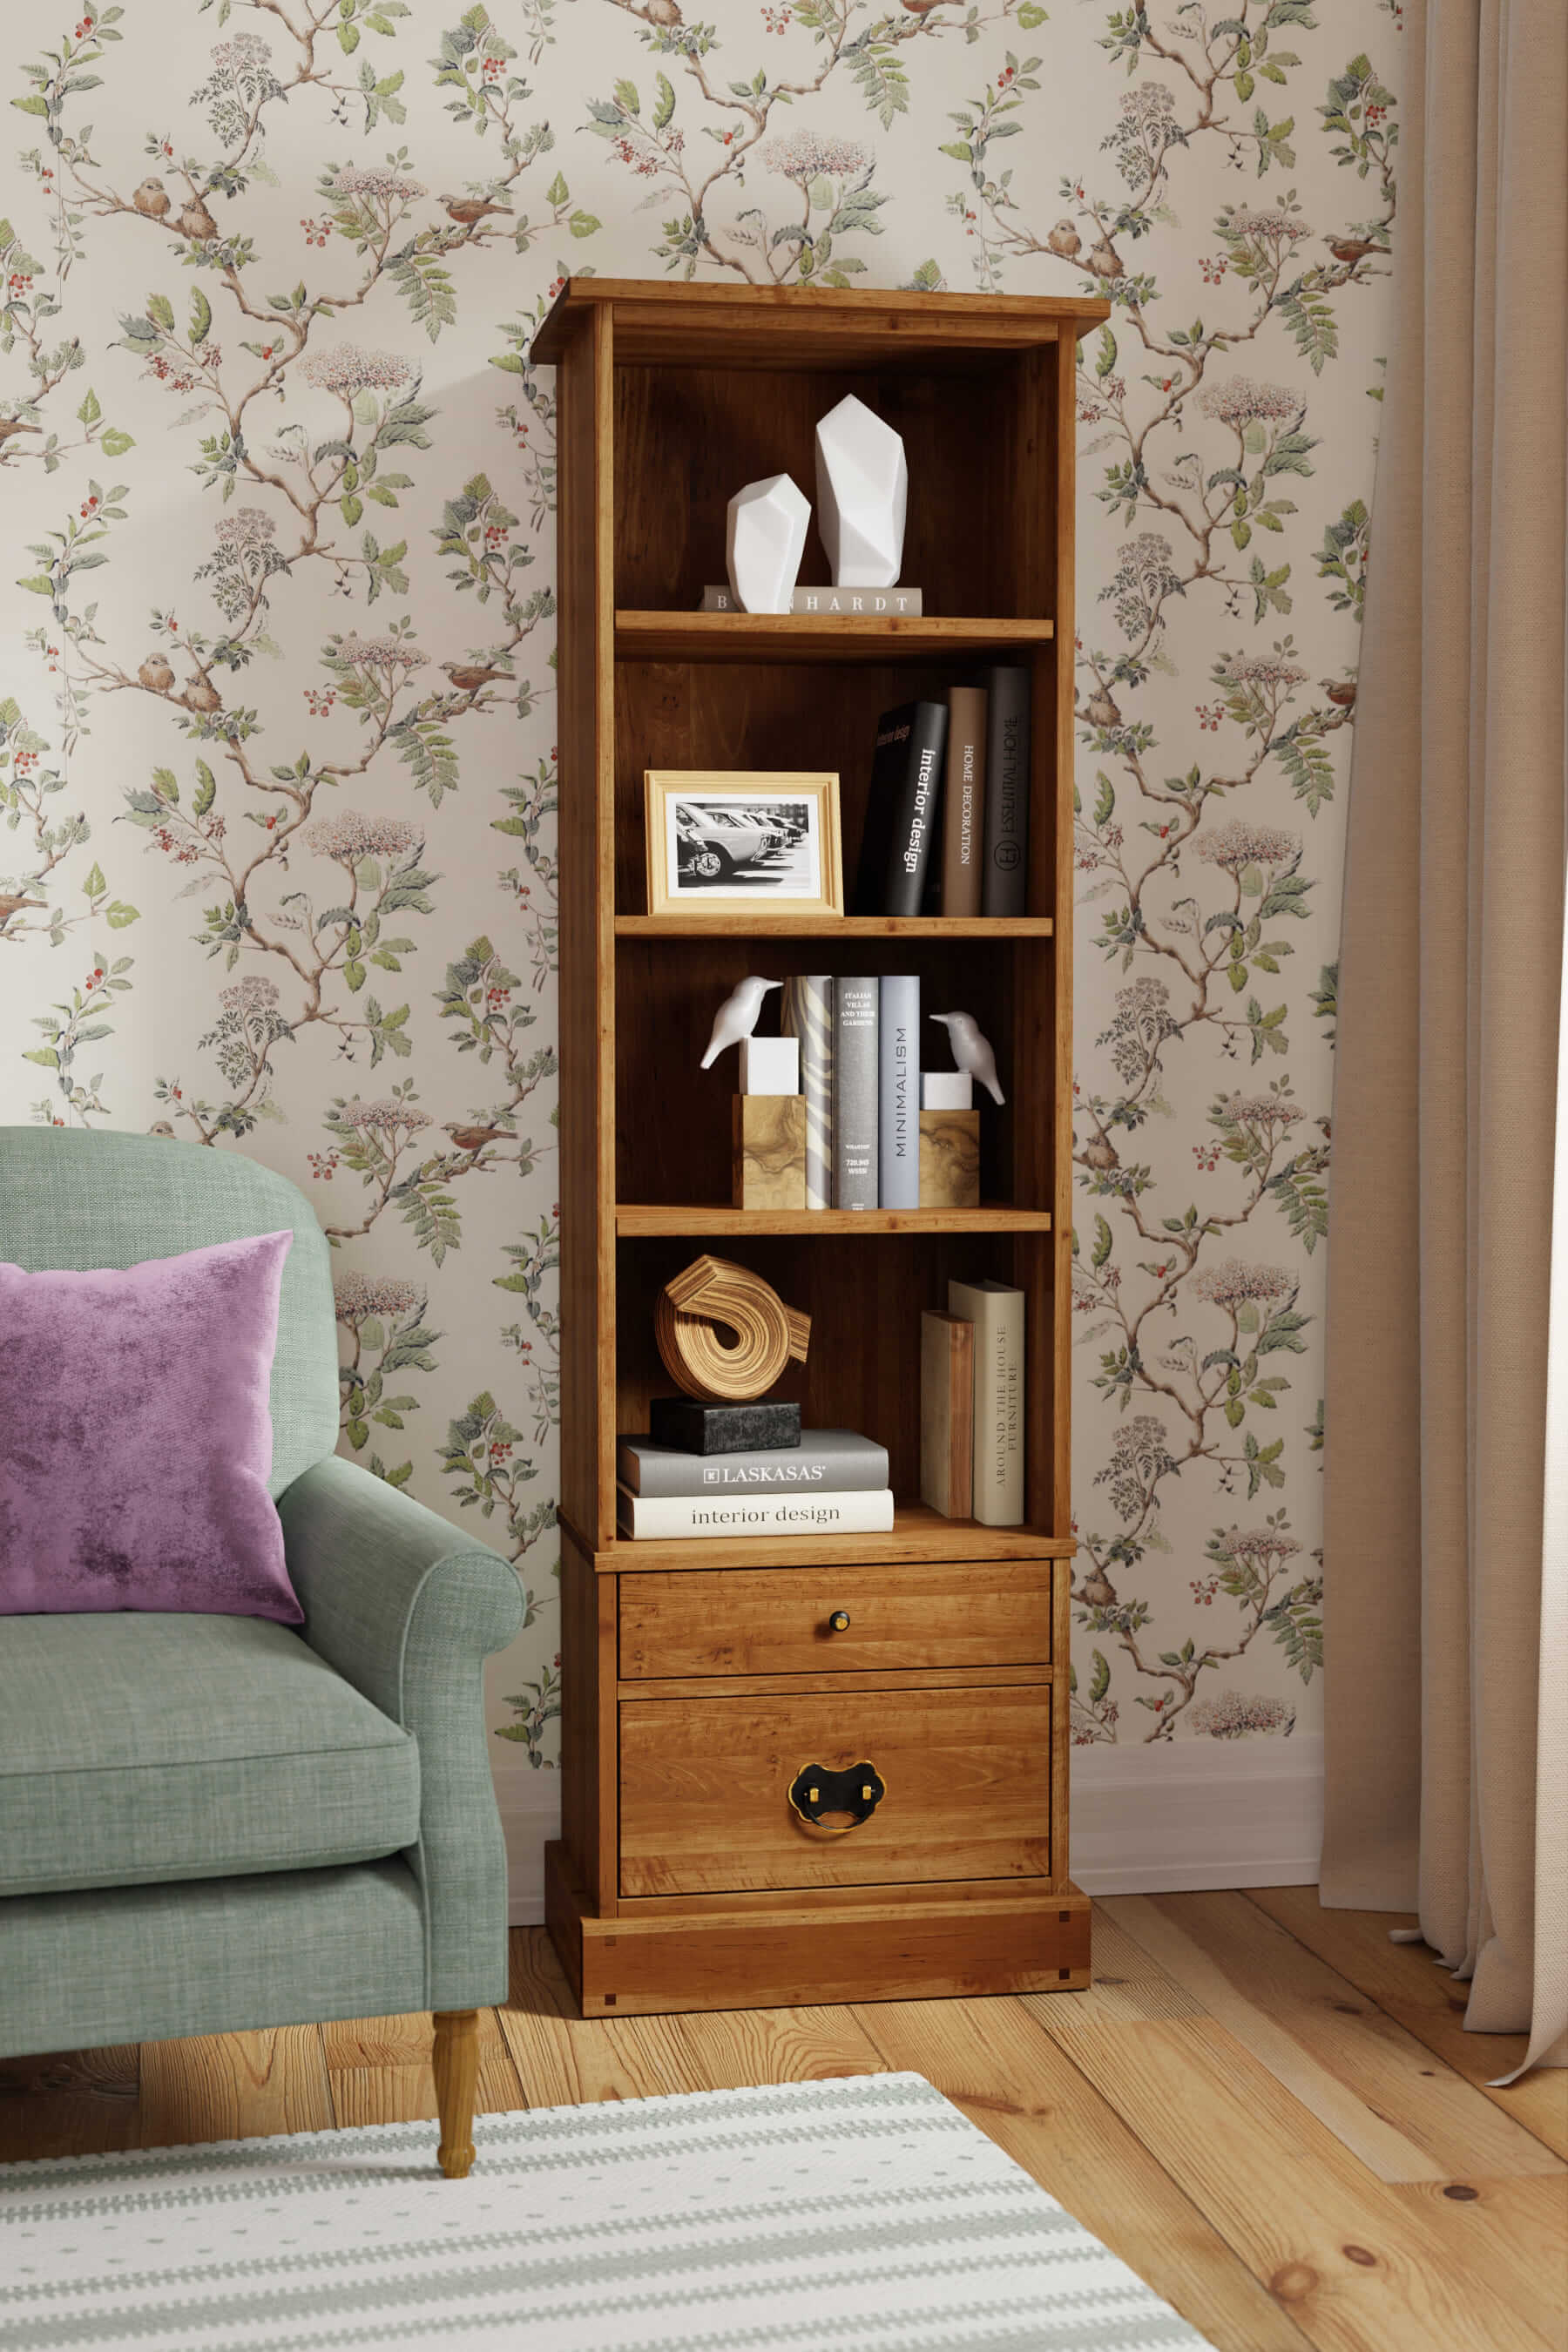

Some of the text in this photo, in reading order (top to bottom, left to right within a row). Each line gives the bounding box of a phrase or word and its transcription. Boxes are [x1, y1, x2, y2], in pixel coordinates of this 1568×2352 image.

[1004, 717, 1018, 760] HOME
[903, 817, 926, 873] design
[961, 745, 974, 865] HOME DECORATION
[896, 1027, 907, 1157] MINIMALISM
[996, 1325, 1007, 1486] AROUND THE HOUSE
[1008, 1362, 1017, 1450] FURNITURE
[692, 1505, 841, 1524] interior design
